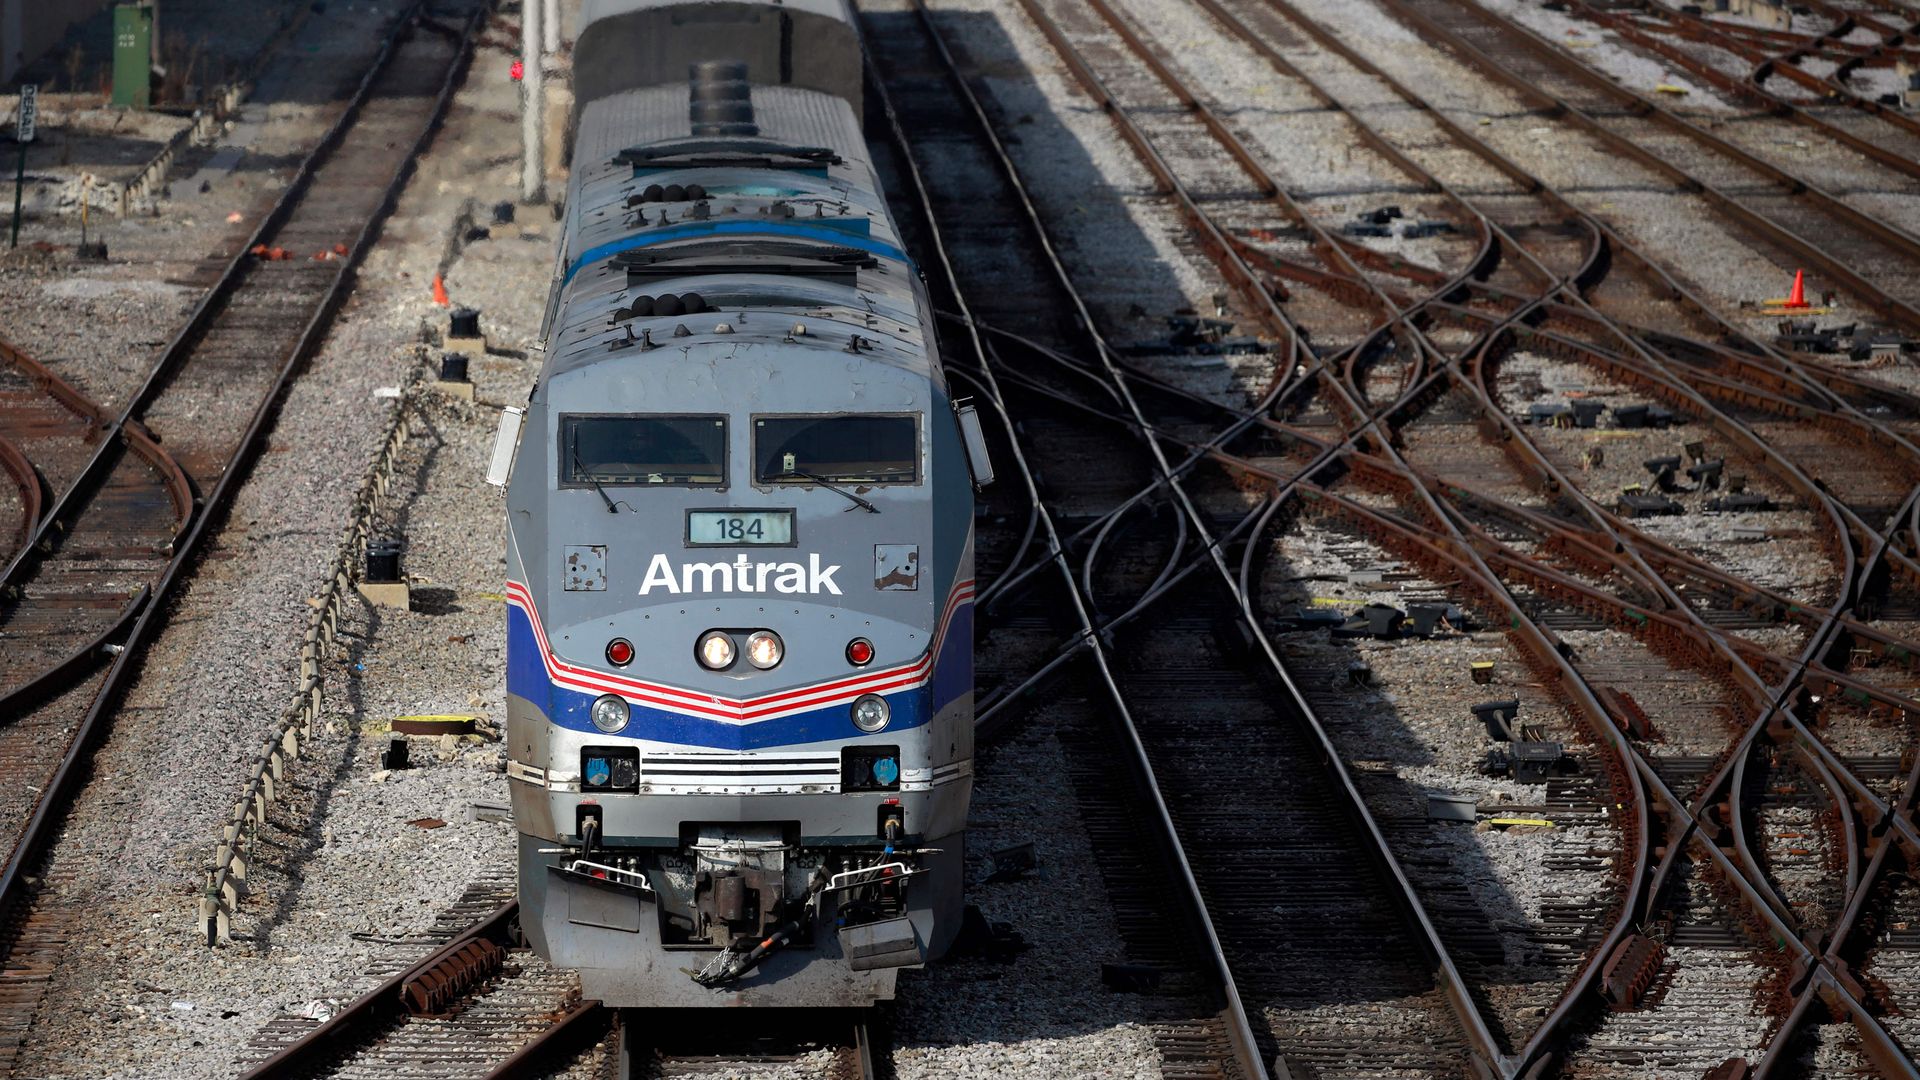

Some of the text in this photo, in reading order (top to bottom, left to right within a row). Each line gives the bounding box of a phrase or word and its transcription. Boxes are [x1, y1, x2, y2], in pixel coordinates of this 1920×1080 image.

[20, 85, 35, 140] DERAIL
[716, 518, 764, 540] 184
[638, 553, 843, 595] Amtrak
